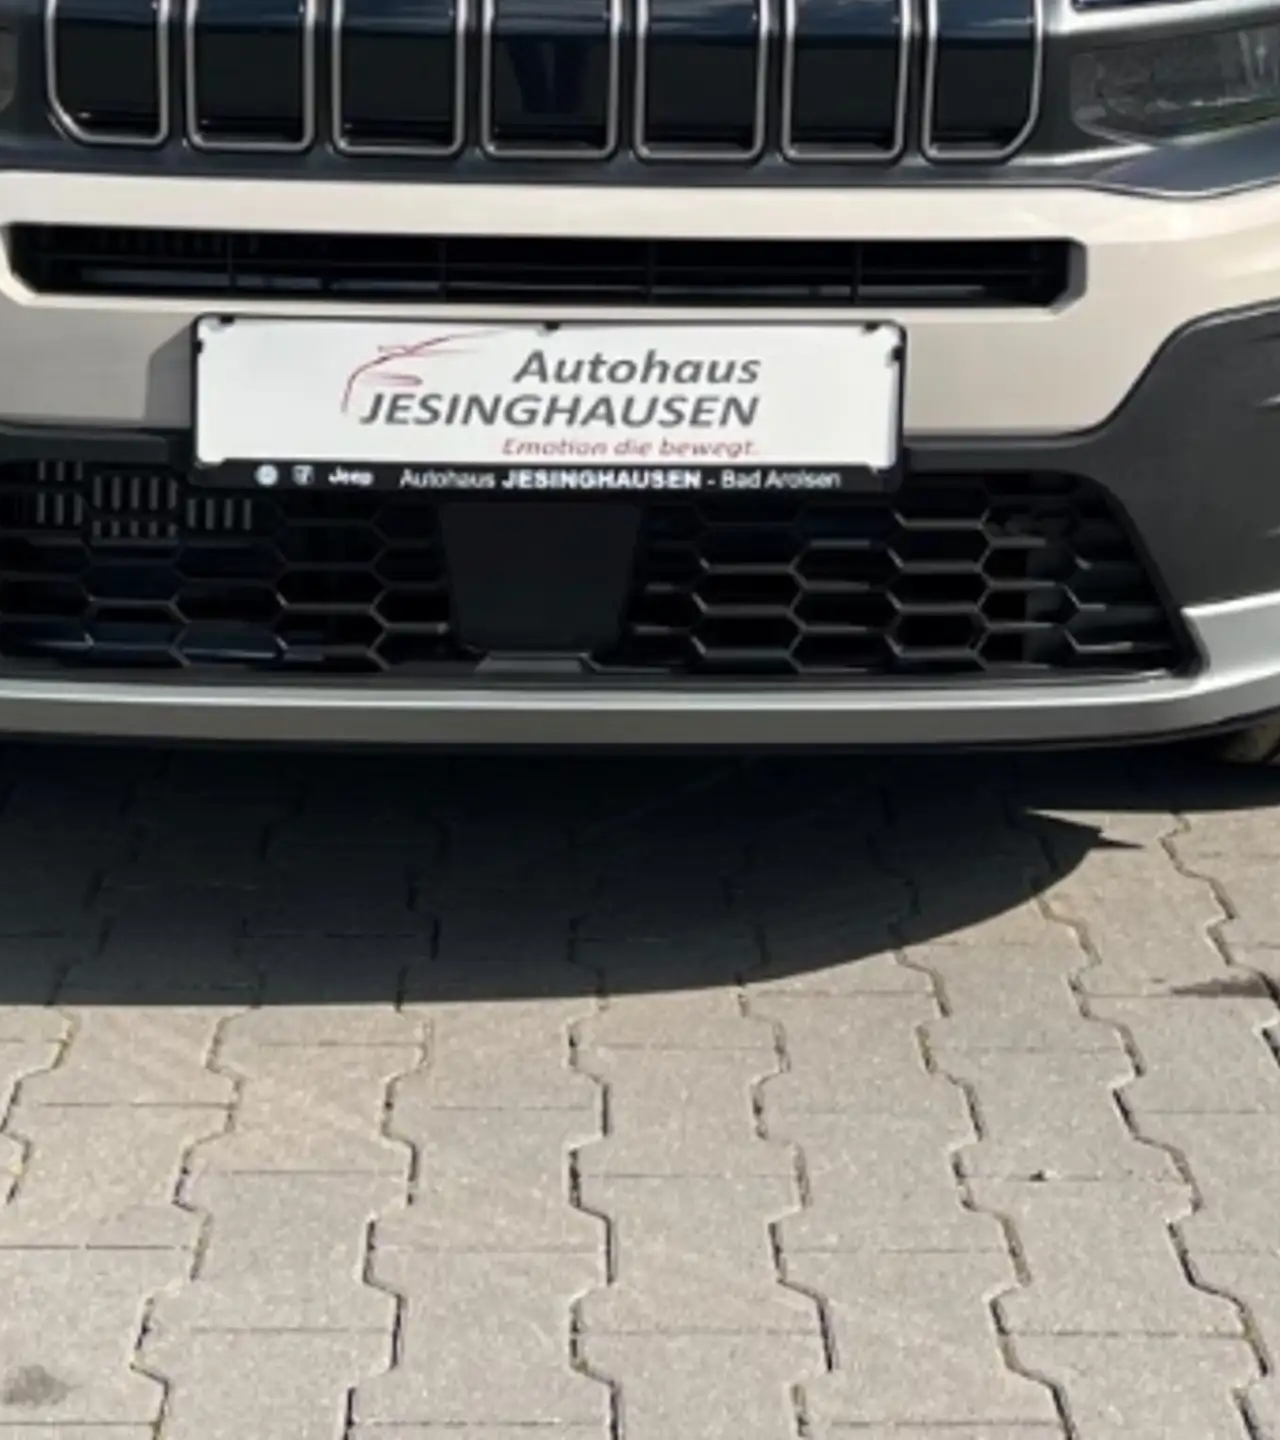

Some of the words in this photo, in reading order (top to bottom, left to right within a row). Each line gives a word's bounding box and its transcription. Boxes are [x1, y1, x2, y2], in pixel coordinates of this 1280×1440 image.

[512, 349, 761, 385] Autohaus
[359, 392, 761, 428] JESINGHAUSEN
[501, 437, 608, 458] Emotion
[614, 436, 652, 457] die
[399, 468, 496, 489] Autohaus
[501, 468, 702, 490] JESINGHAUSEN
[721, 469, 761, 489] Bad
[764, 469, 841, 490] Arolsen
